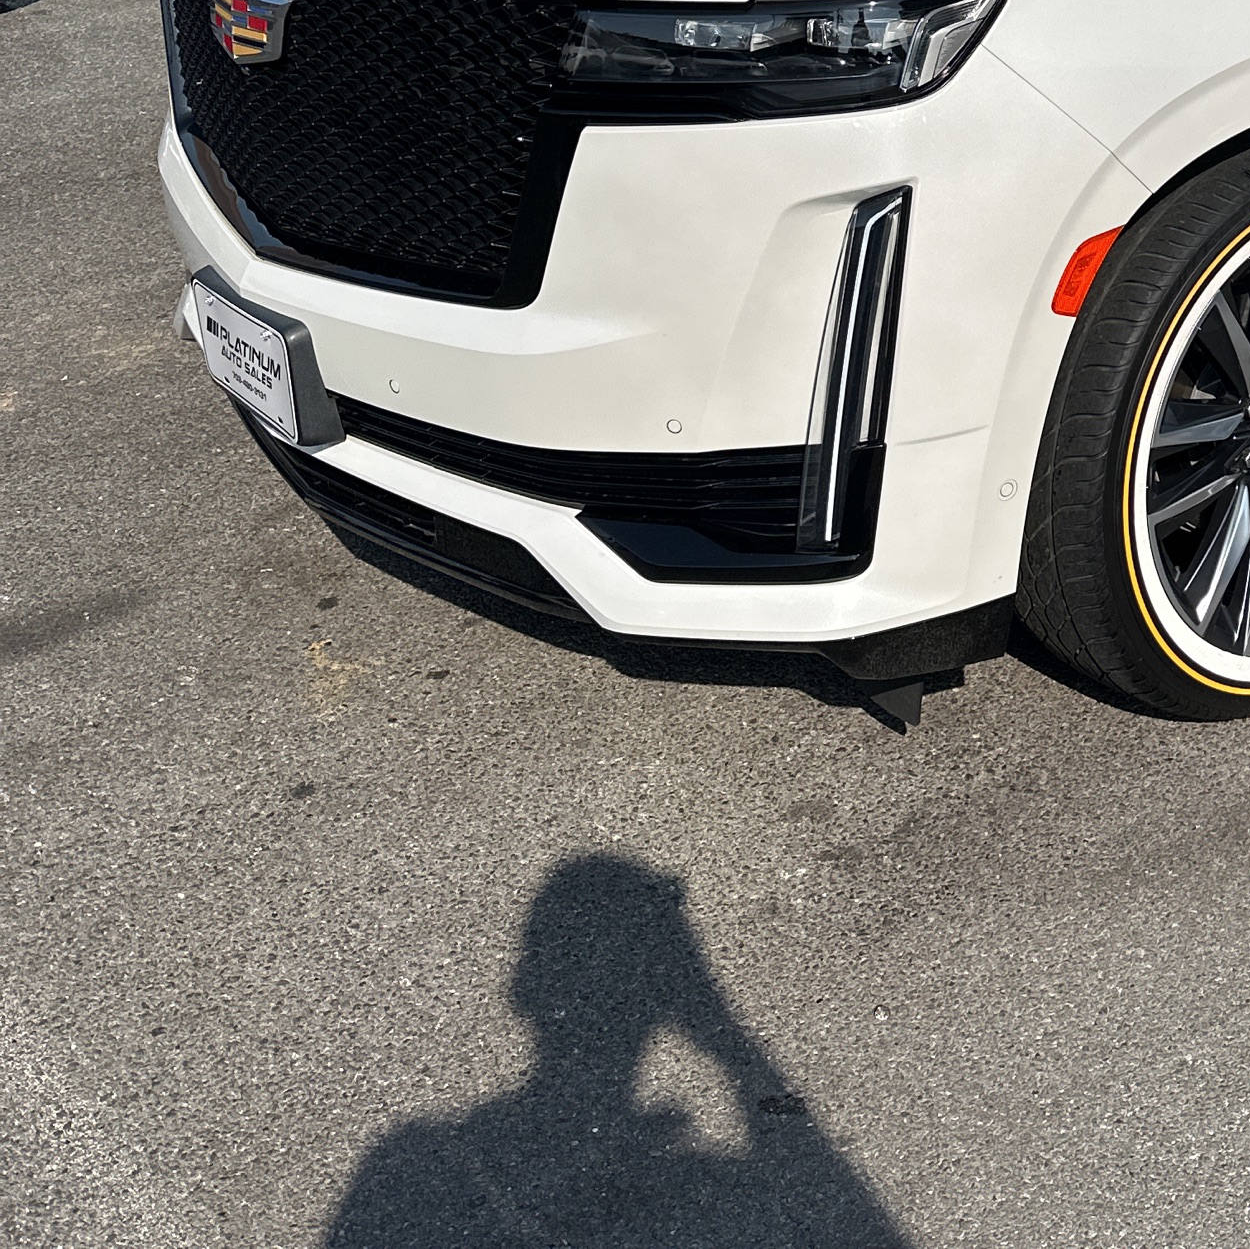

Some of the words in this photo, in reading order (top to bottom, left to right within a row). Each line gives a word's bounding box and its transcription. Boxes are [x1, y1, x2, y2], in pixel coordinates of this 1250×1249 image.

[220, 325, 281, 381] PLATINUM
[221, 345, 242, 369] AUTO
[244, 362, 273, 390] SALES
